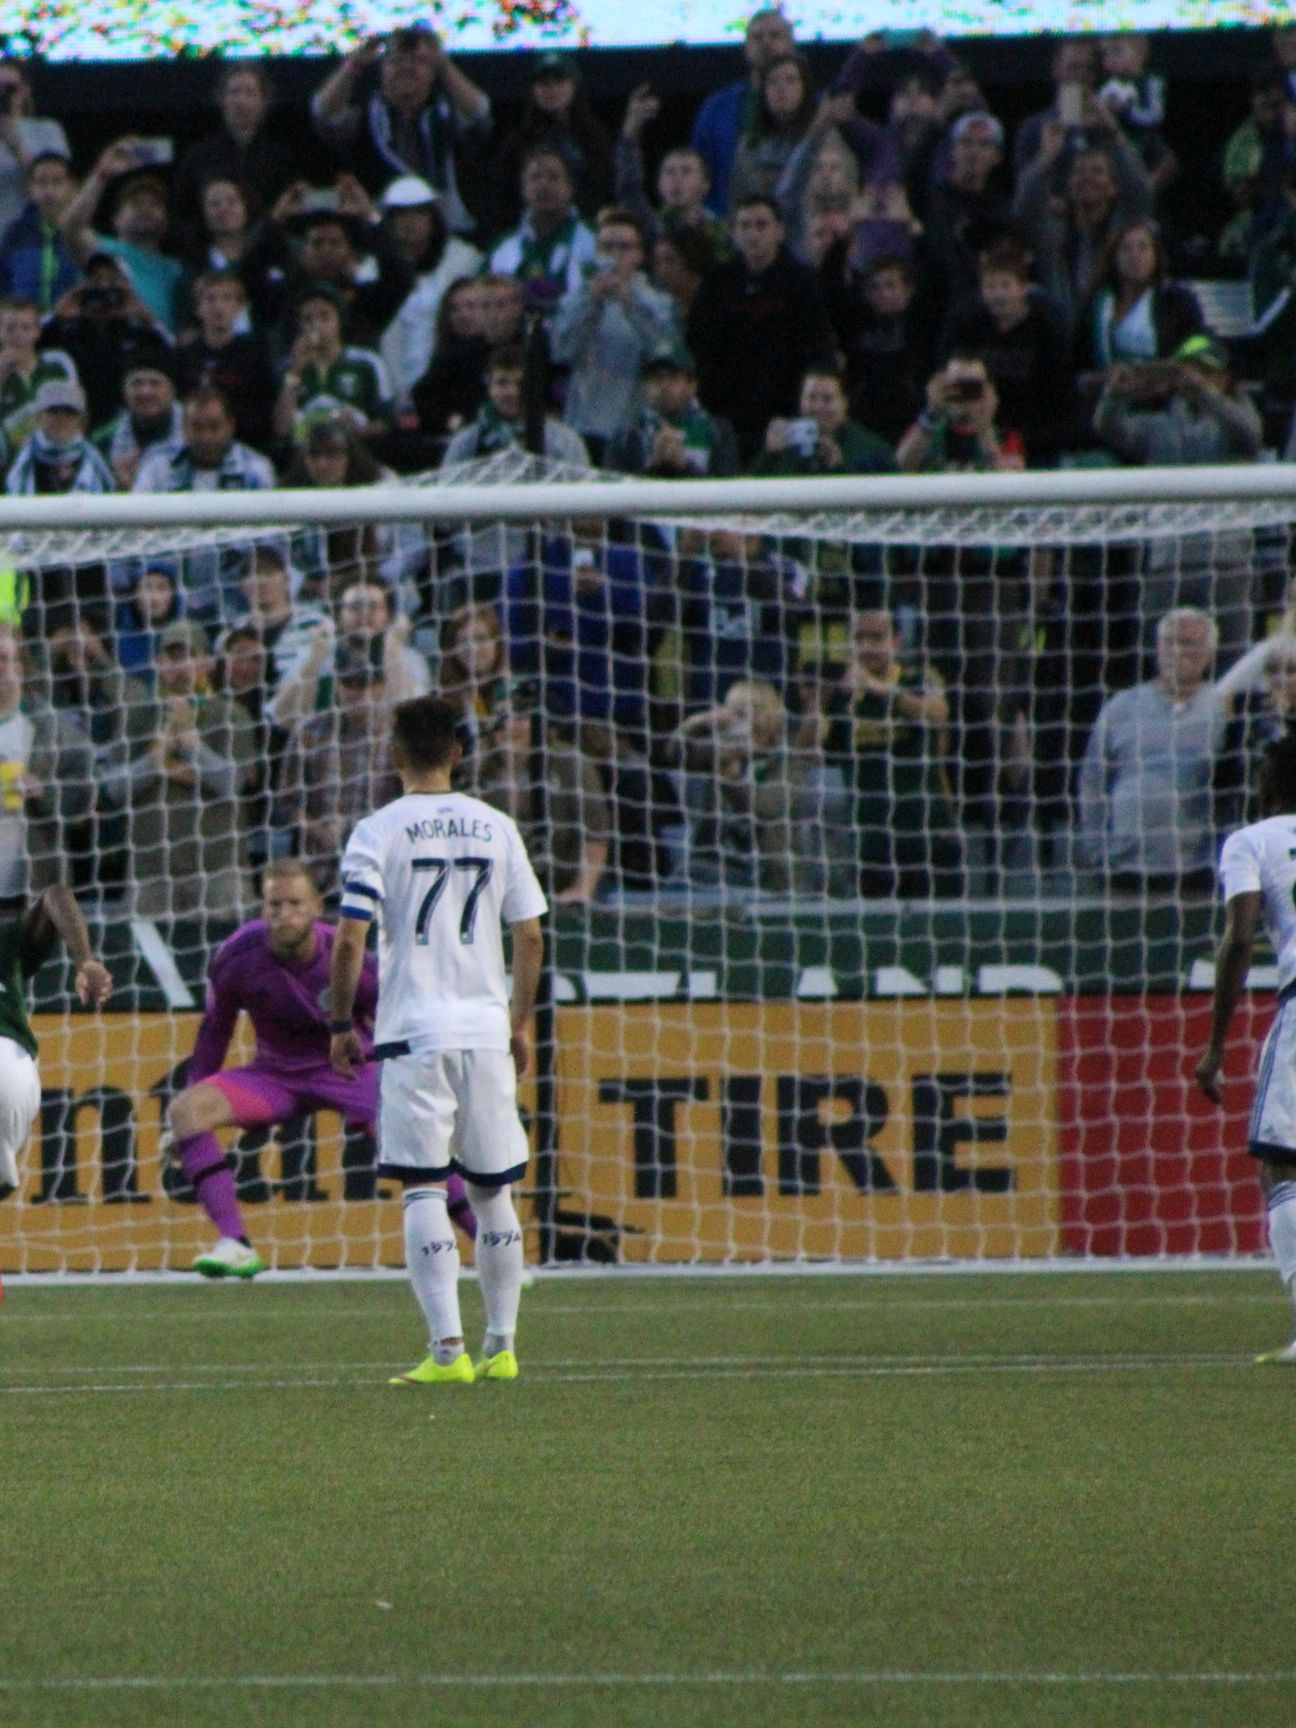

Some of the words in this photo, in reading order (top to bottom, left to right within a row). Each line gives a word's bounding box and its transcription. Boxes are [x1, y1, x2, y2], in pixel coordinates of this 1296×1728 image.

[406, 818, 493, 843] MORALES
[411, 856, 494, 946] 77
[598, 1072, 1018, 1199] TIRE
[421, 1238, 456, 1256] 197
